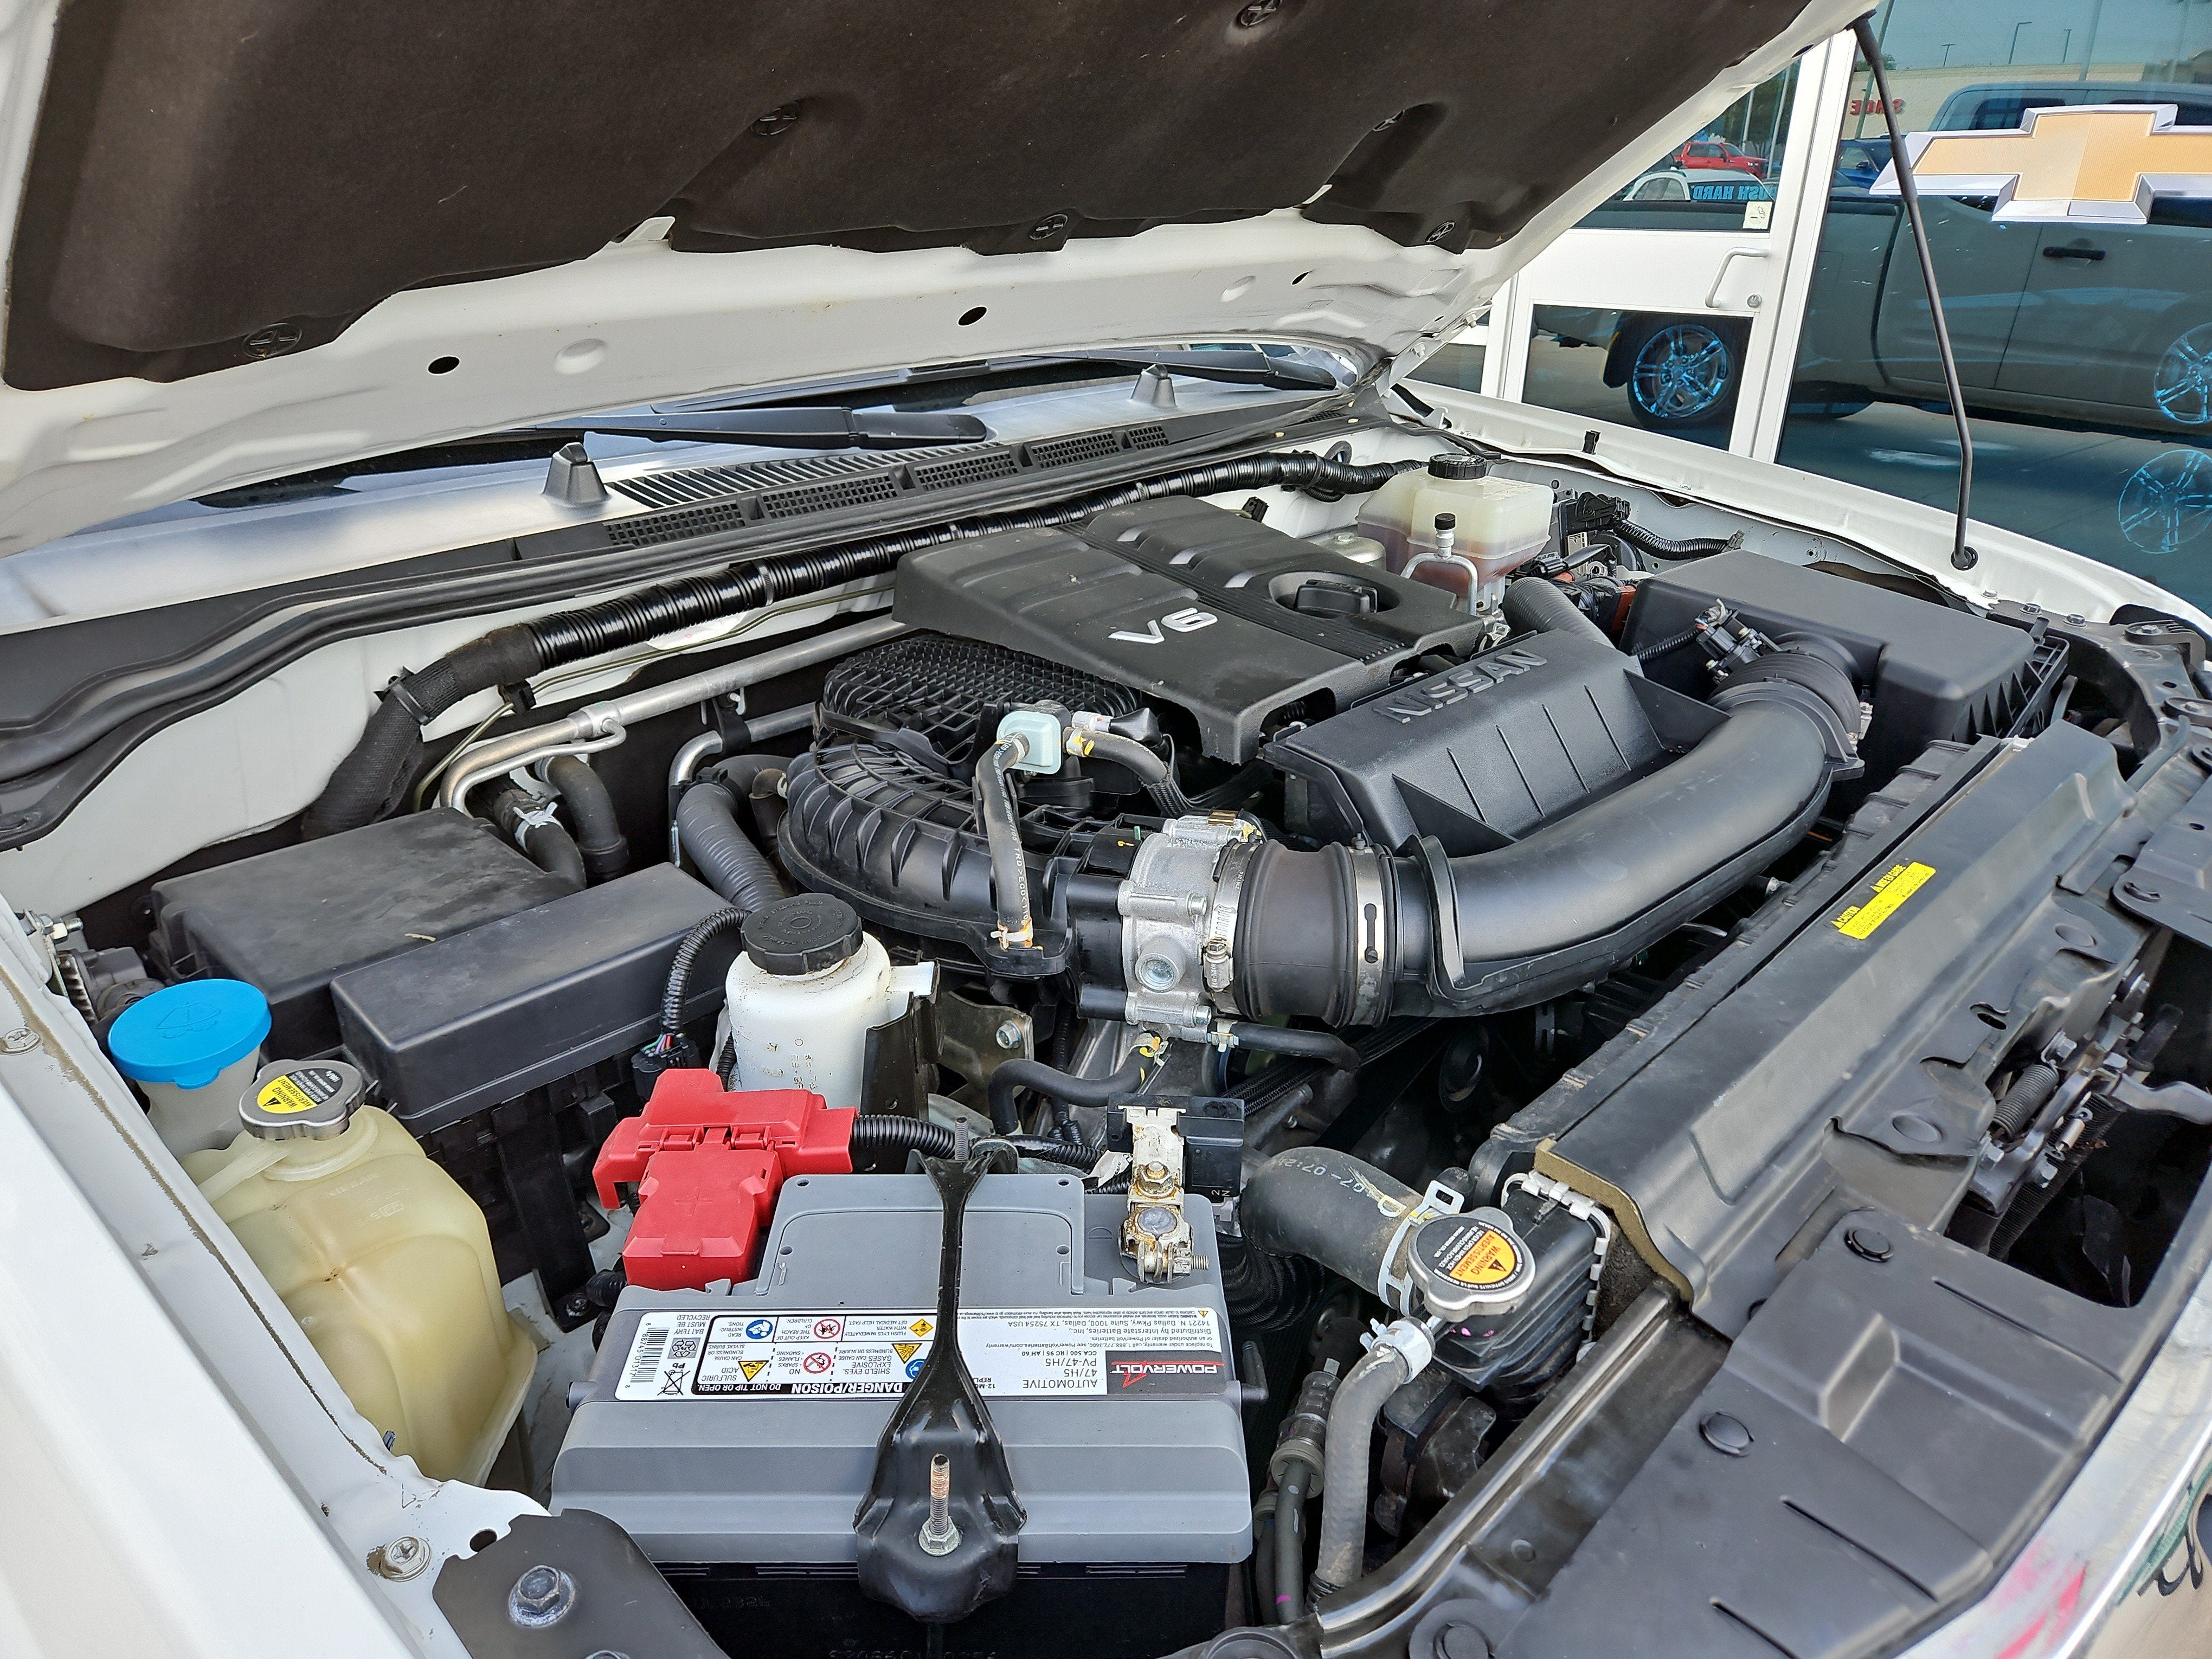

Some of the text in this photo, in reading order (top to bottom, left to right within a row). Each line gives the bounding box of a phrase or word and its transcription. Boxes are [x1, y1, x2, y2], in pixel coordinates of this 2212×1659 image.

[1108, 607, 1218, 644] V6
[1373, 648, 1547, 724] NISSAN
[1837, 905, 1861, 923] CAUTION
[272, 1086, 298, 1108] WARNING
[278, 1078, 313, 1107] AVERTISSEMENT
[1454, 1233, 1495, 1276] AVERTISSEMENT
[1470, 1244, 1501, 1275] WARNING
[636, 1334, 649, 1353] 88745
[629, 1356, 640, 1376] 01317
[1045, 1358, 1097, 1366] PV-47/H5
[1111, 1365, 1217, 1373] POWERVOLT
[1064, 1368, 1097, 1377] 47/H5
[792, 1382, 903, 1393] DANGER/POISON
[1023, 1379, 1097, 1388] AUTOMOTIVE
